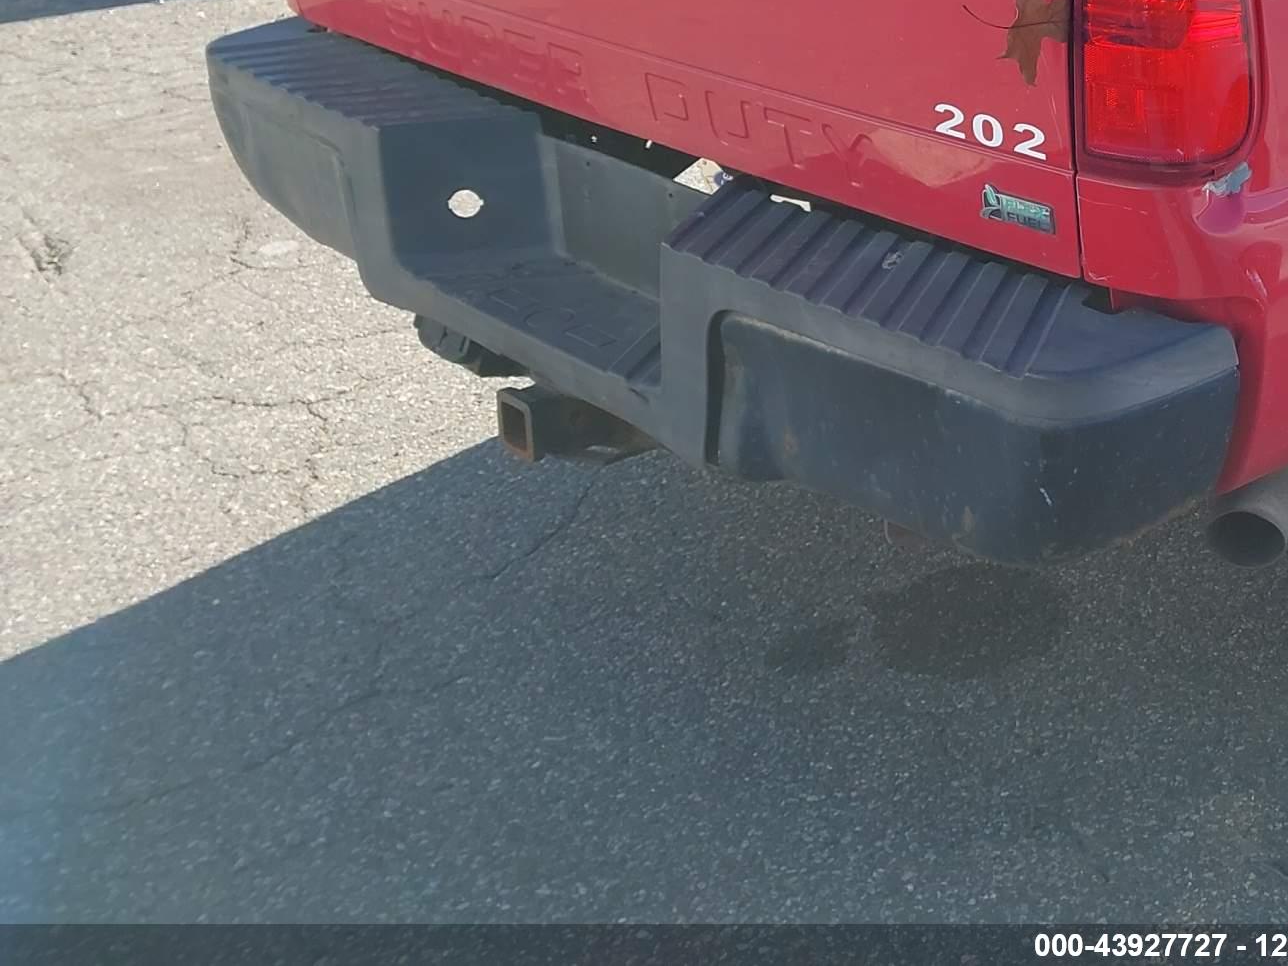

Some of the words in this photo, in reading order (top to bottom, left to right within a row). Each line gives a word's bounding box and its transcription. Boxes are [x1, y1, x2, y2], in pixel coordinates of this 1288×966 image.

[645, 71, 873, 188] DUTY
[934, 103, 1047, 161] 202
[1006, 211, 1048, 232] FUEL
